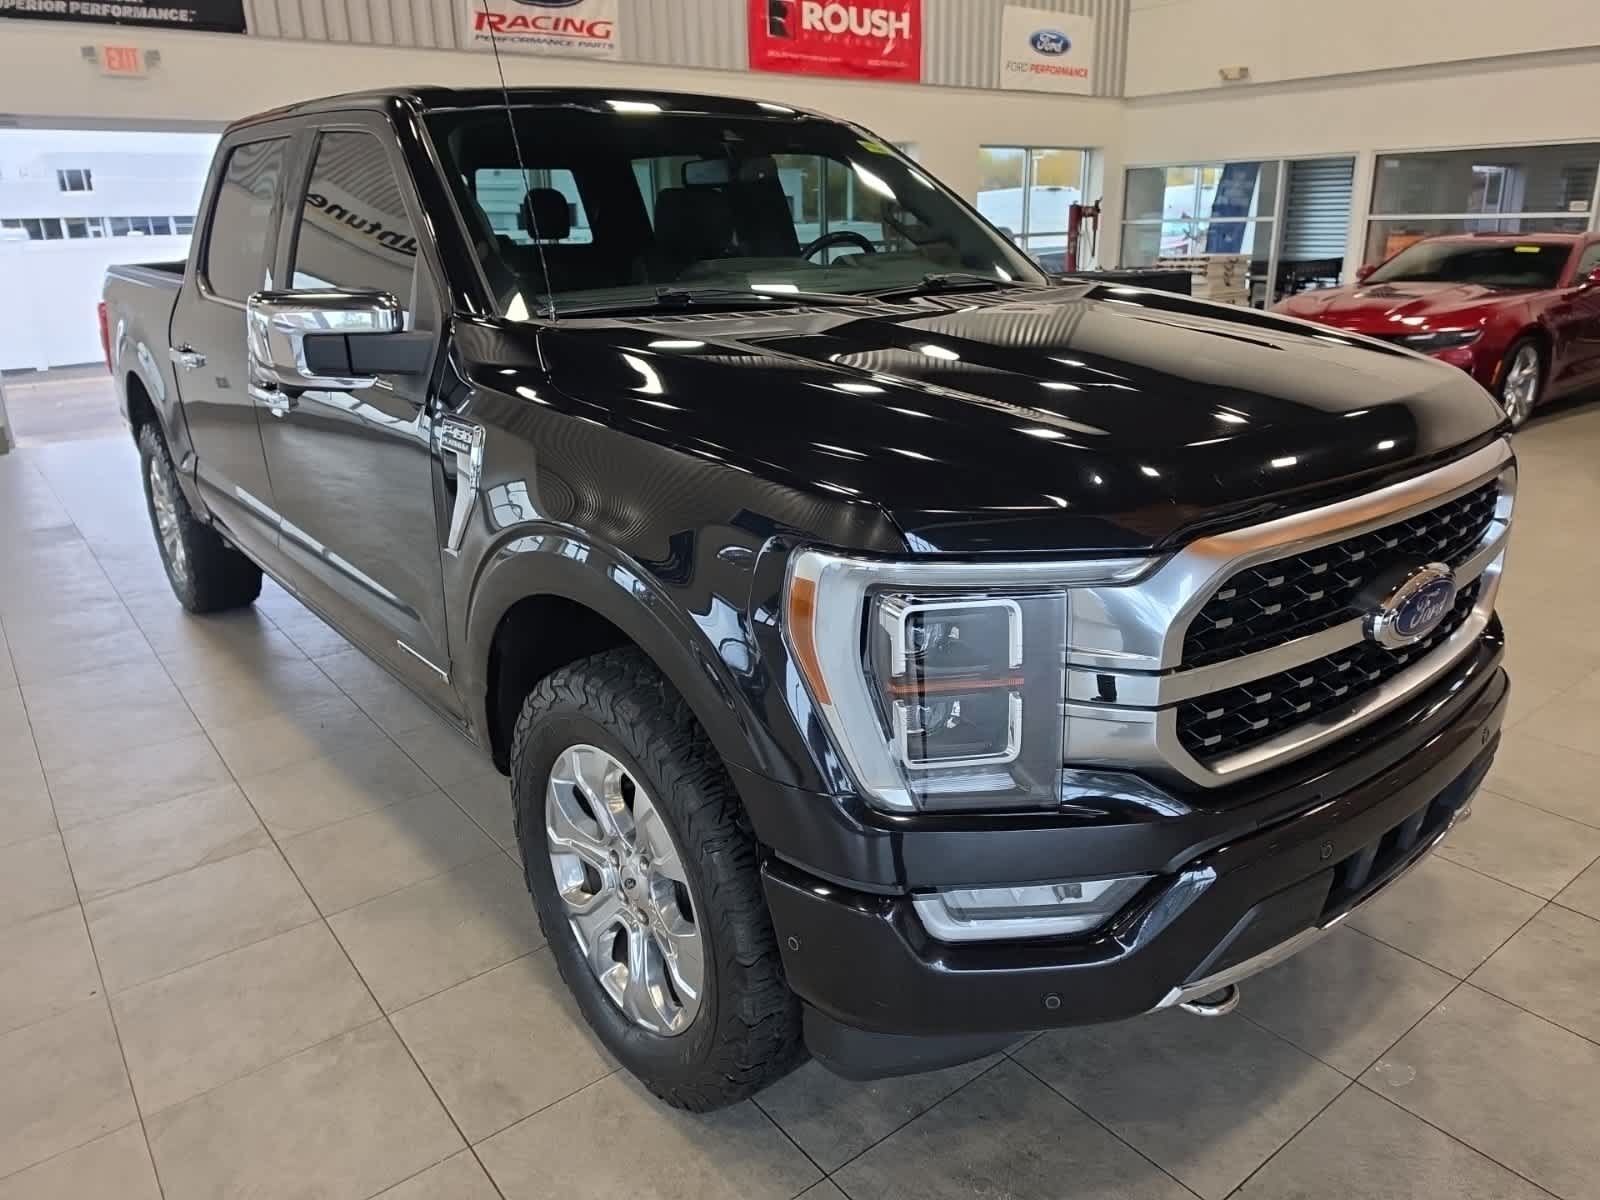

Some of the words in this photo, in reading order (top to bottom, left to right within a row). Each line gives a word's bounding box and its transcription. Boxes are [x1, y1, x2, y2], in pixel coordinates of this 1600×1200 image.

[474, 12, 612, 39] RACING
[801, 2, 911, 39] ROUSH
[474, 34, 576, 48] PERFORMANCE
[577, 40, 614, 49] PARTS
[1036, 33, 1064, 52] Ford
[1006, 61, 1028, 73] FORD
[1029, 63, 1089, 79] PERFORMANCE
[1410, 587, 1448, 629] Ford
